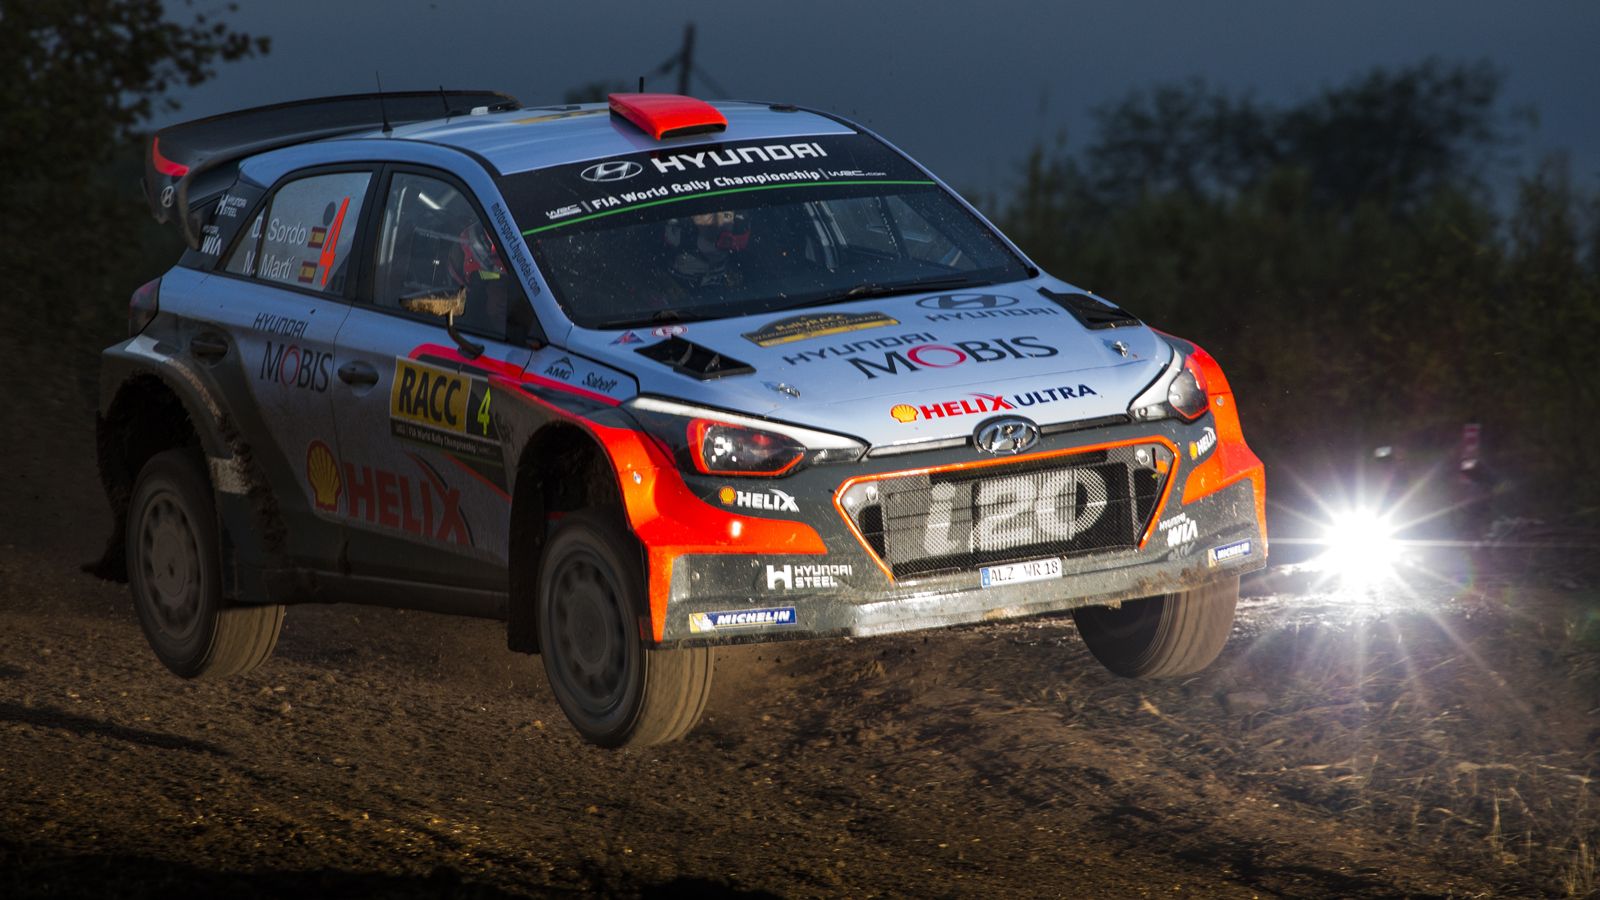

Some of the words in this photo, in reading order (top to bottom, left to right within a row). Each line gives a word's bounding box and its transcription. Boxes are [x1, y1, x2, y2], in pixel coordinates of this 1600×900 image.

[650, 142, 828, 173] HYUNDAI
[545, 203, 582, 219] WRC
[591, 196, 620, 210] FIA
[620, 186, 668, 203] World
[671, 178, 711, 194] Rally
[714, 169, 821, 187] Championship
[223, 206, 238, 218] STEEL
[267, 218, 308, 245] Sordo
[319, 196, 350, 287] 4
[491, 202, 541, 297] motorsport.hyundai.com
[260, 253, 294, 280] Martí
[252, 312, 309, 339] HYUNDAI
[925, 308, 1060, 323] HYUNDAI
[782, 332, 938, 366] HYUNDAI
[845, 336, 1059, 380] MOBIS
[260, 341, 333, 393] MOBIS
[544, 366, 572, 381] AMG
[398, 366, 462, 426] RACC
[919, 393, 1014, 420] HELIX
[1014, 384, 1097, 407] ULTRA
[477, 386, 491, 436] 4
[418, 430, 431, 442] World
[431, 432, 444, 448] Rally
[342, 455, 473, 547] HELIX
[737, 489, 800, 512] HELIX
[794, 564, 853, 576] HYUNDAI
[795, 576, 838, 588] STEEL
[991, 566, 1015, 581] ALZ
[1023, 562, 1041, 577] WR
[1044, 560, 1059, 575] 18
[717, 610, 791, 625] MICHELIN
